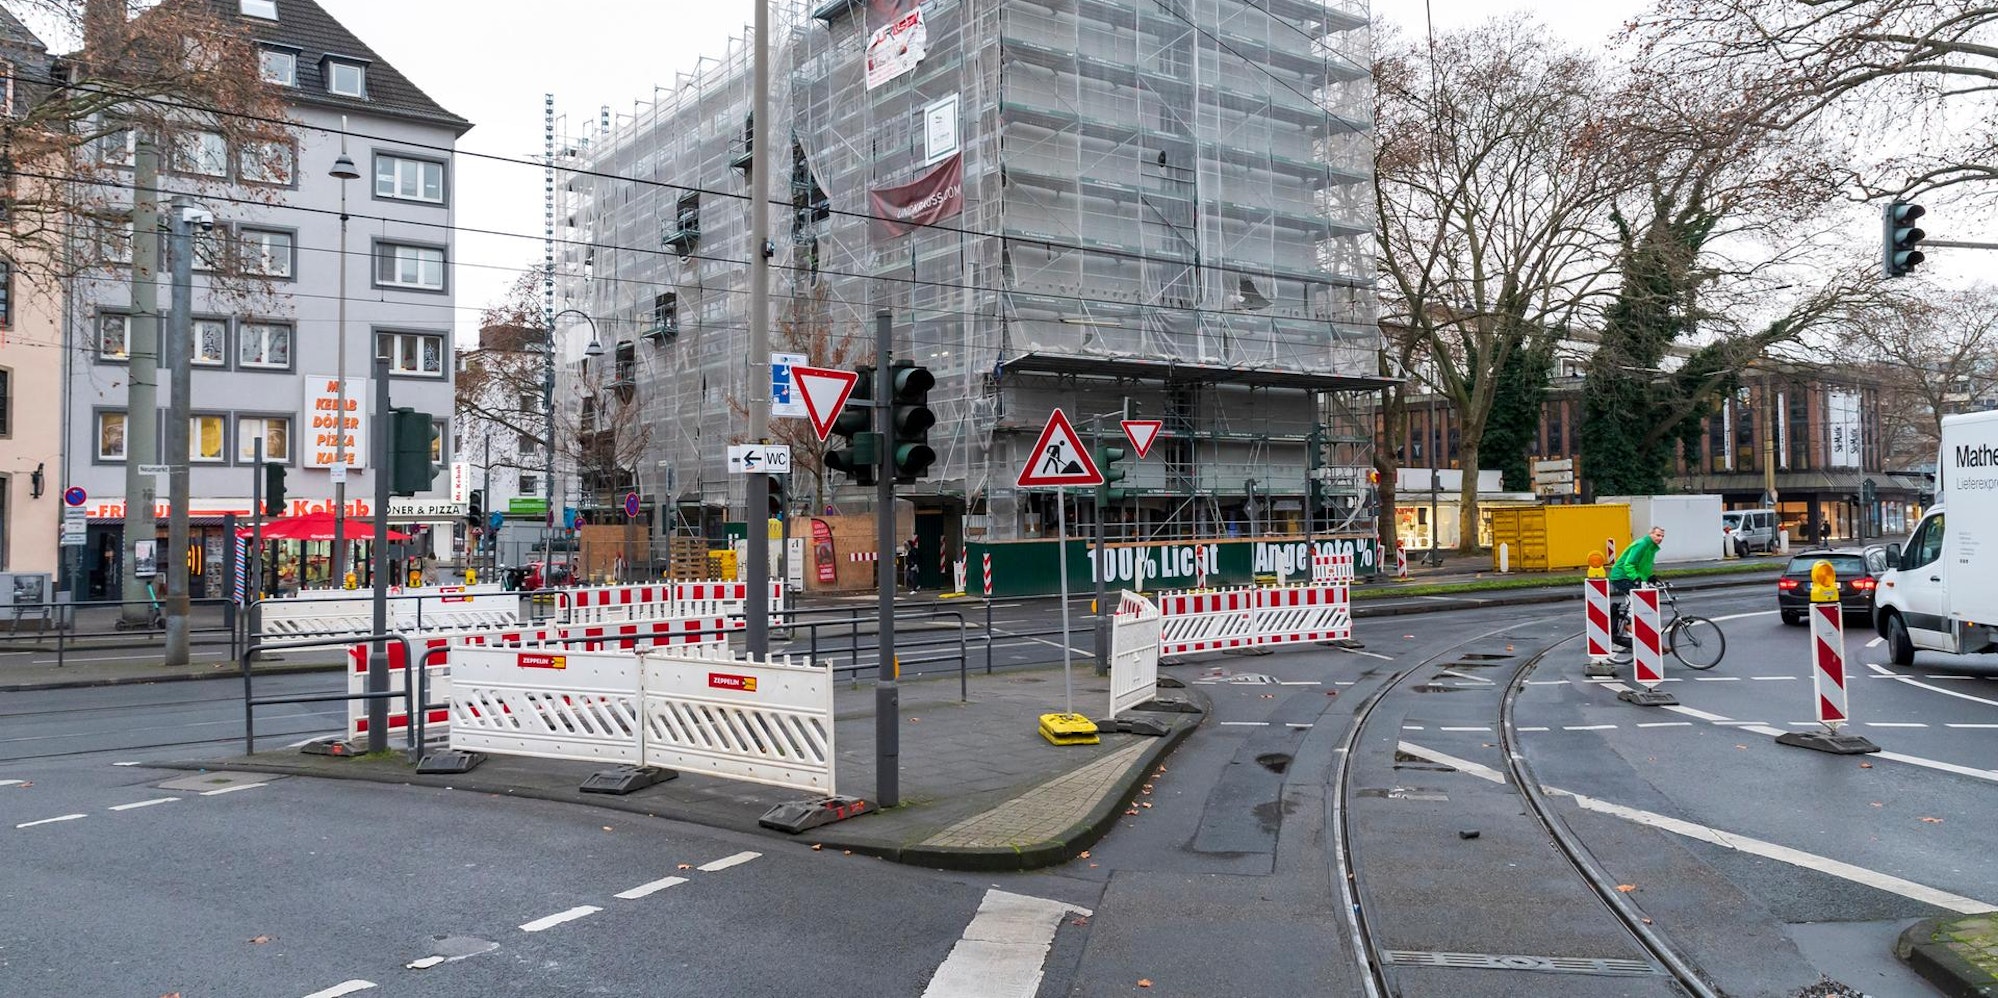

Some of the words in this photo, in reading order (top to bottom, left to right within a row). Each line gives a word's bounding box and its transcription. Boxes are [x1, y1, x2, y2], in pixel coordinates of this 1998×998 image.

[766, 452, 787, 465] WC
[292, 499, 369, 518] Kebab
[417, 505, 425, 514] &
[429, 505, 460, 514] PIZZA
[1087, 546, 1157, 583] 100%
[522, 656, 550, 665] ZEPPELIN
[713, 677, 740, 686] ZEPPELIN
